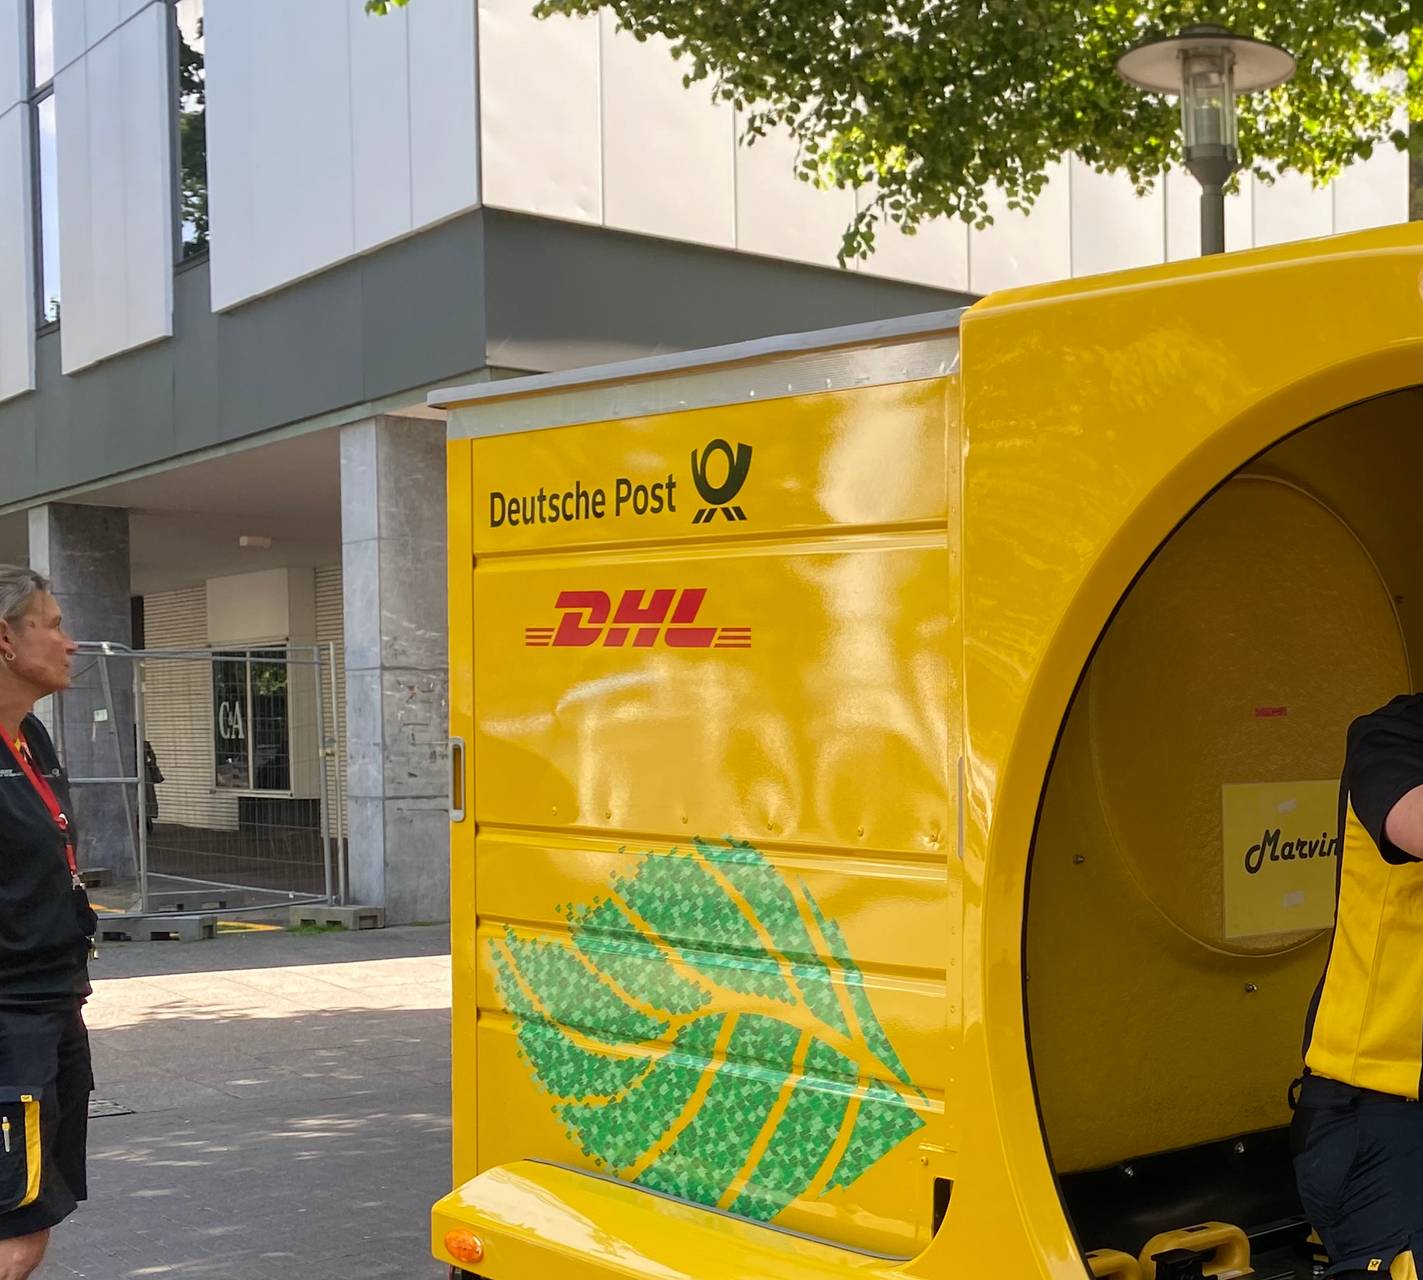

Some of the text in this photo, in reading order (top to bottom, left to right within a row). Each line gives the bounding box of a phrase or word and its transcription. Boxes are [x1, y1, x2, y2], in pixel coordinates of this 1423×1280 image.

[490, 473, 676, 528] Deutsche Post
[552, 588, 719, 648] DHL
[219, 701, 245, 739] C&A
[1244, 828, 1340, 875] Marvin
